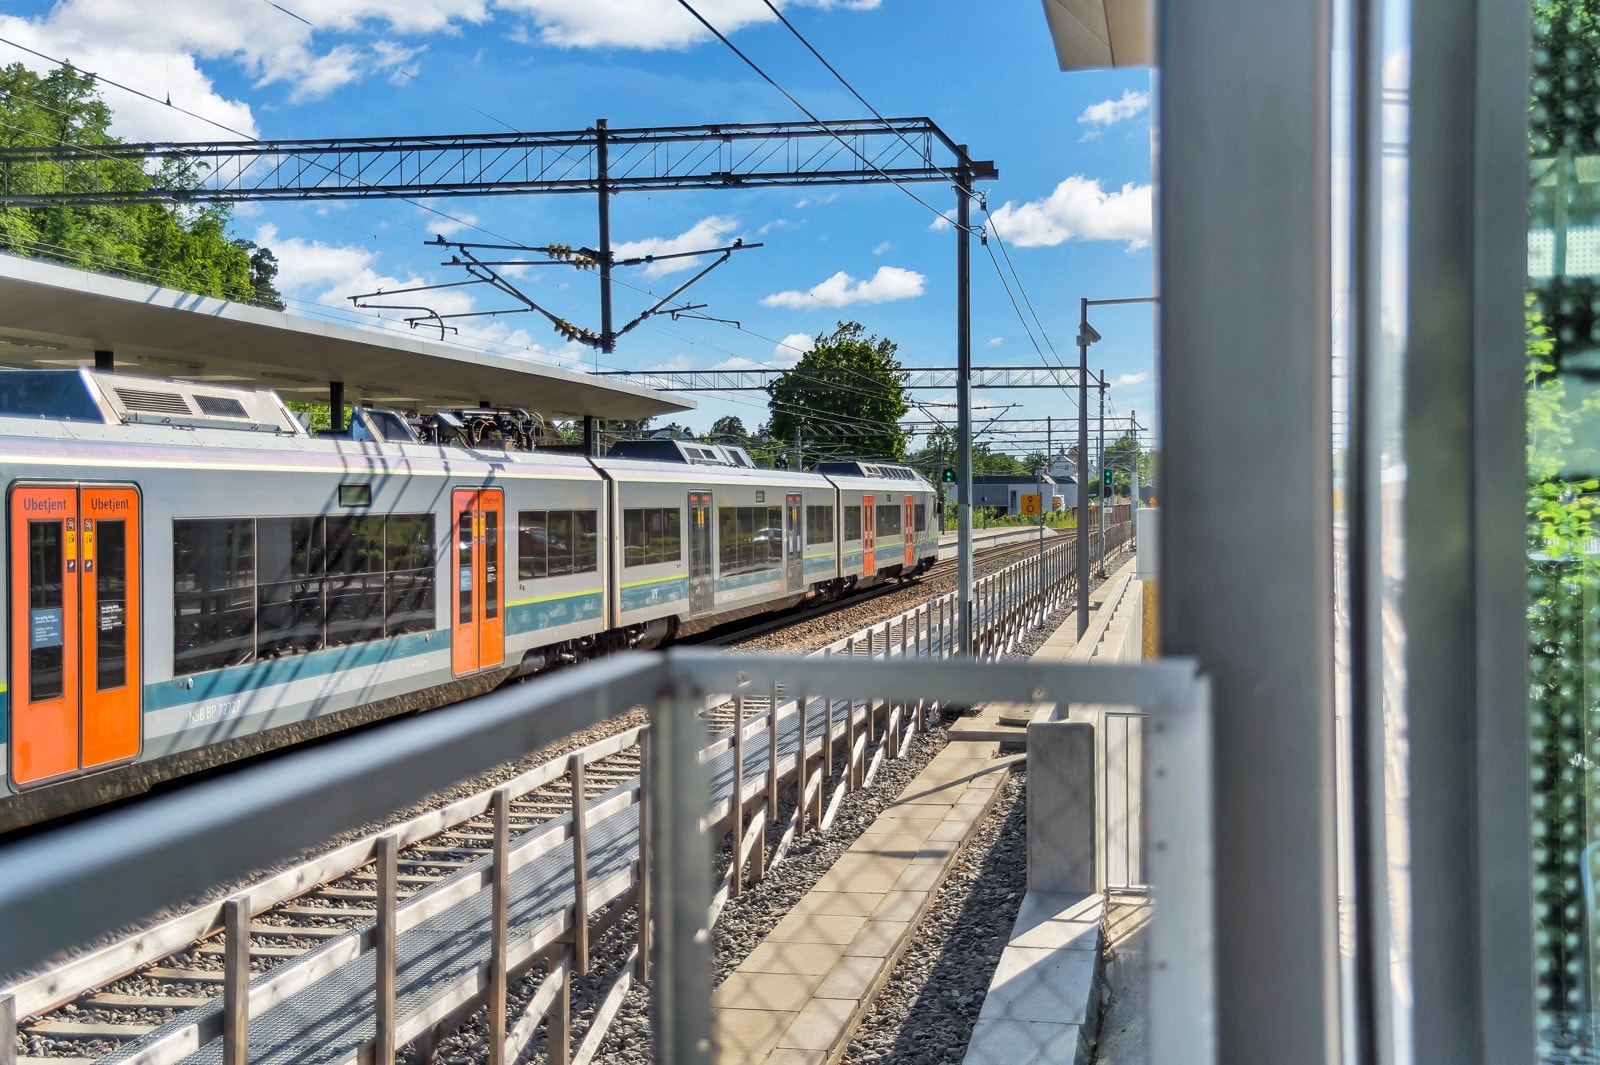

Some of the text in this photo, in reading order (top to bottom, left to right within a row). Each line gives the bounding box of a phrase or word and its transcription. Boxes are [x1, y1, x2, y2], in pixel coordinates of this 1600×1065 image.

[23, 498, 66, 513] Ubetjent
[91, 498, 129, 512] Ubetjent
[1028, 496, 1033, 504] 9
[189, 708, 204, 723] NSB
